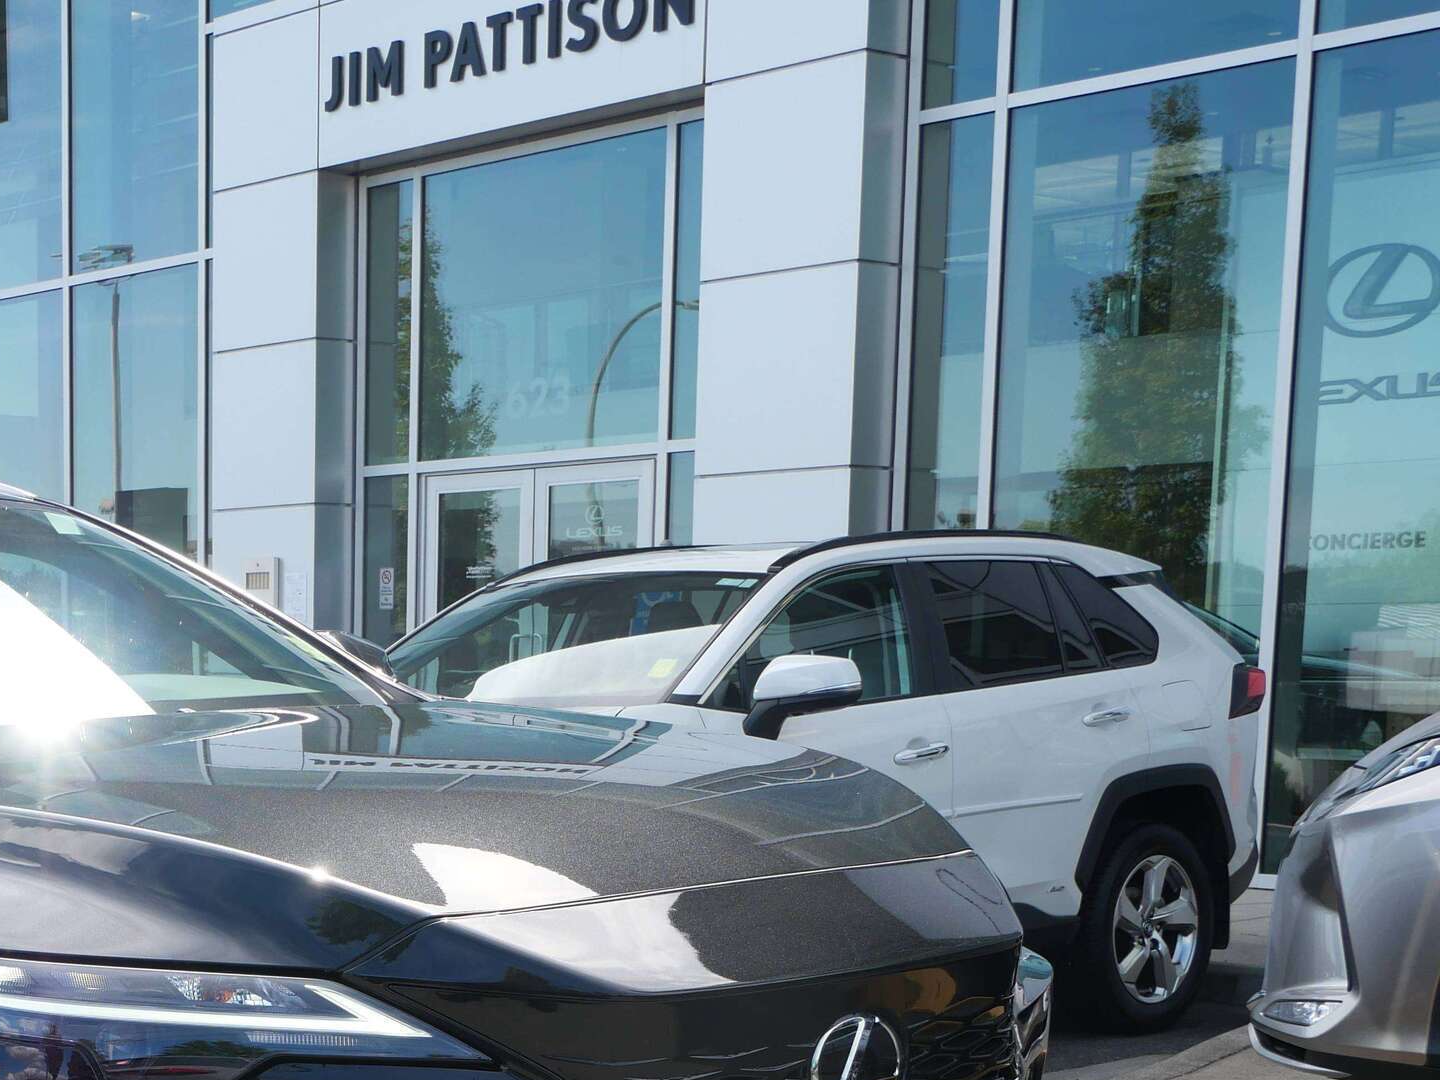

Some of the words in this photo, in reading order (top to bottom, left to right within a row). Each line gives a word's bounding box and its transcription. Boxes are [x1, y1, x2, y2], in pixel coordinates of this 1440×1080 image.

[325, 40, 405, 112] JIM
[566, 524, 624, 539] LEXUS
[1308, 530, 1427, 552] ONCIERGE
